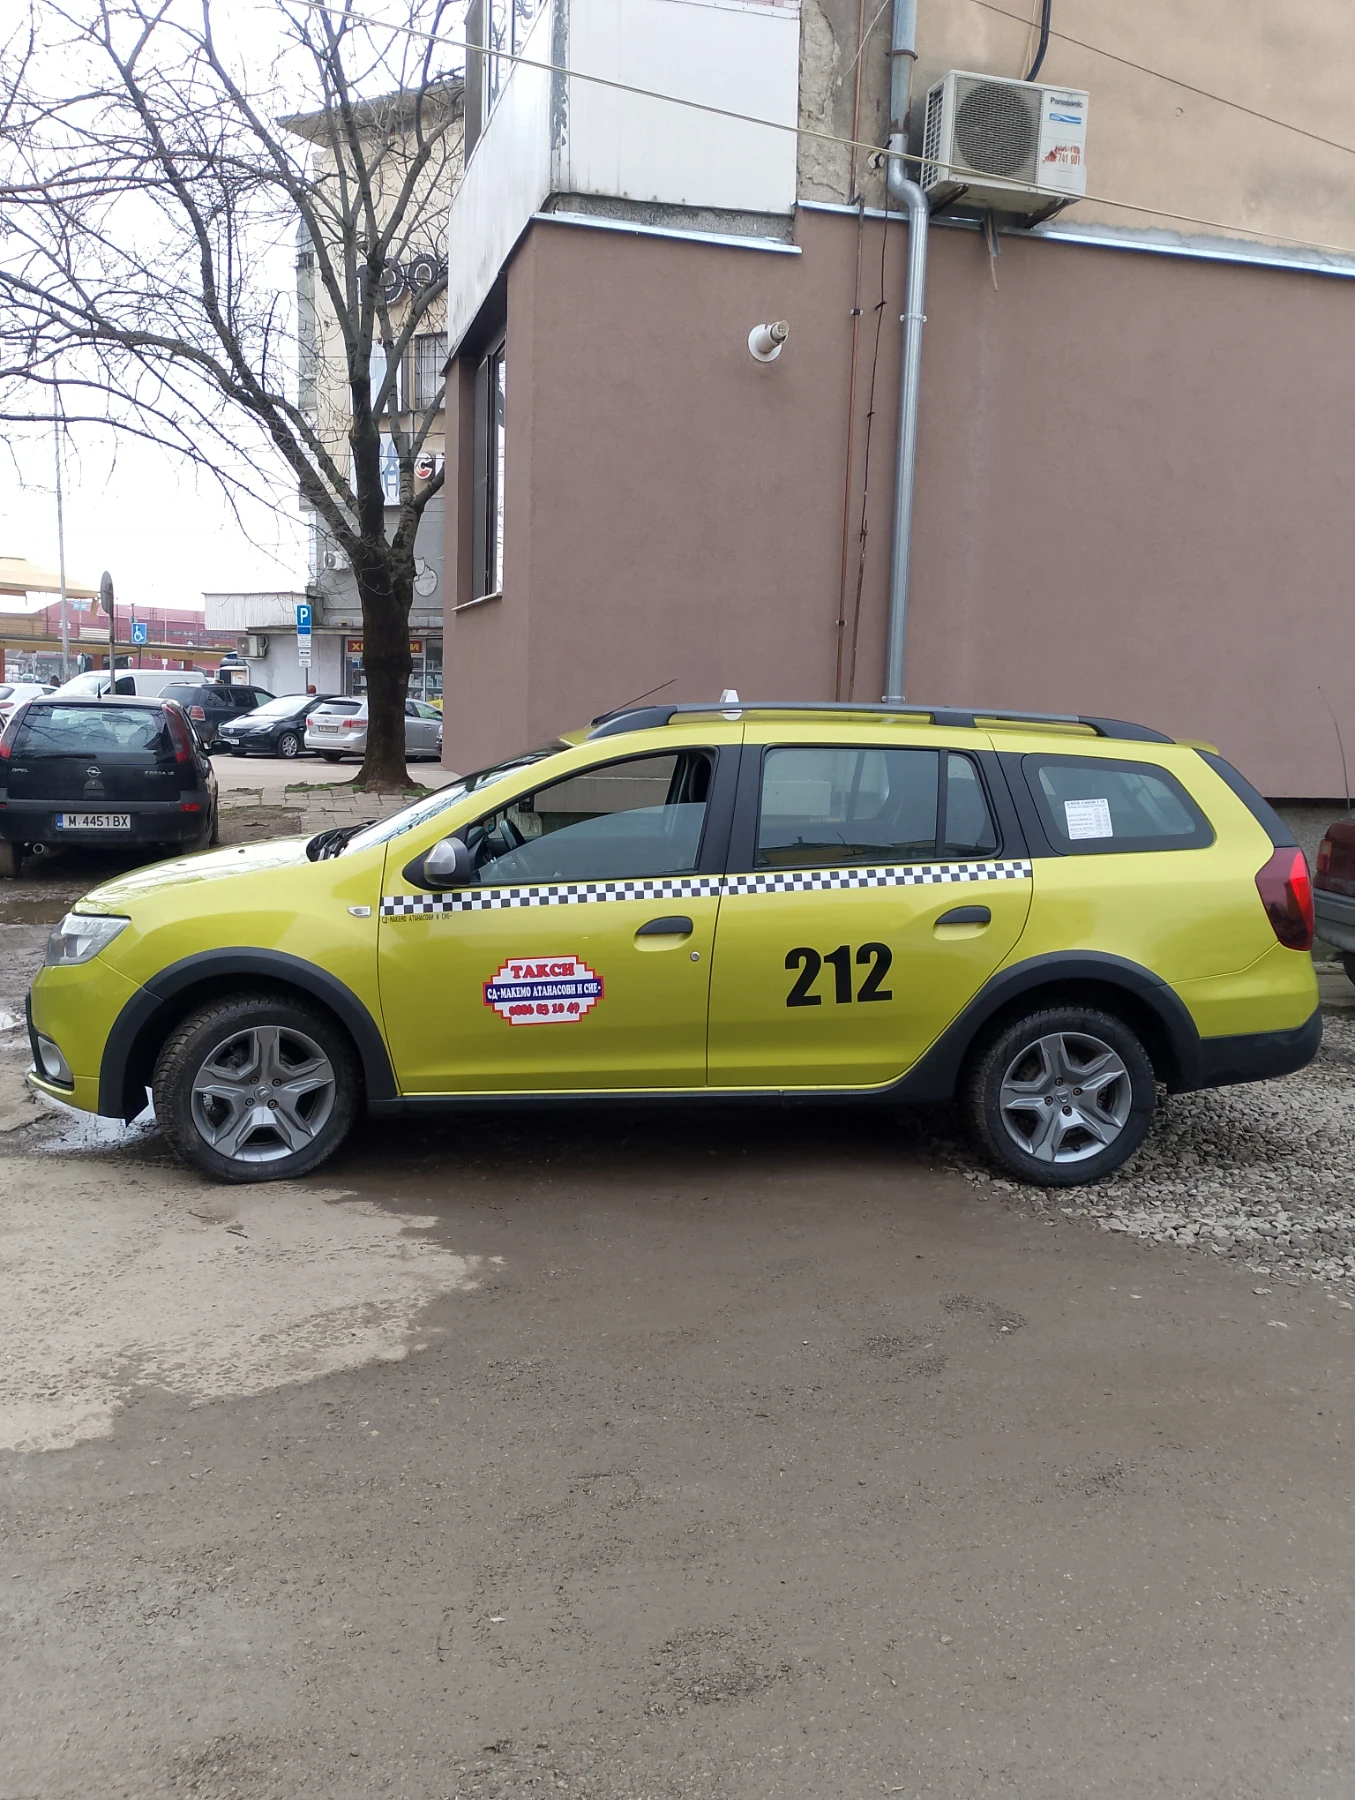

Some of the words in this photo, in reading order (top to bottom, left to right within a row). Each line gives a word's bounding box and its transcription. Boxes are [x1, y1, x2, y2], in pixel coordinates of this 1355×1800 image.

[1050, 97, 1083, 108] Panasonic
[300, 607, 309, 624] P
[510, 962, 575, 979] ТАКСИ
[784, 941, 893, 1008] 212
[533, 982, 576, 998] АТАНАСОВИ
[552, 1003, 565, 1014] 10
[567, 1002, 580, 1014] 49
